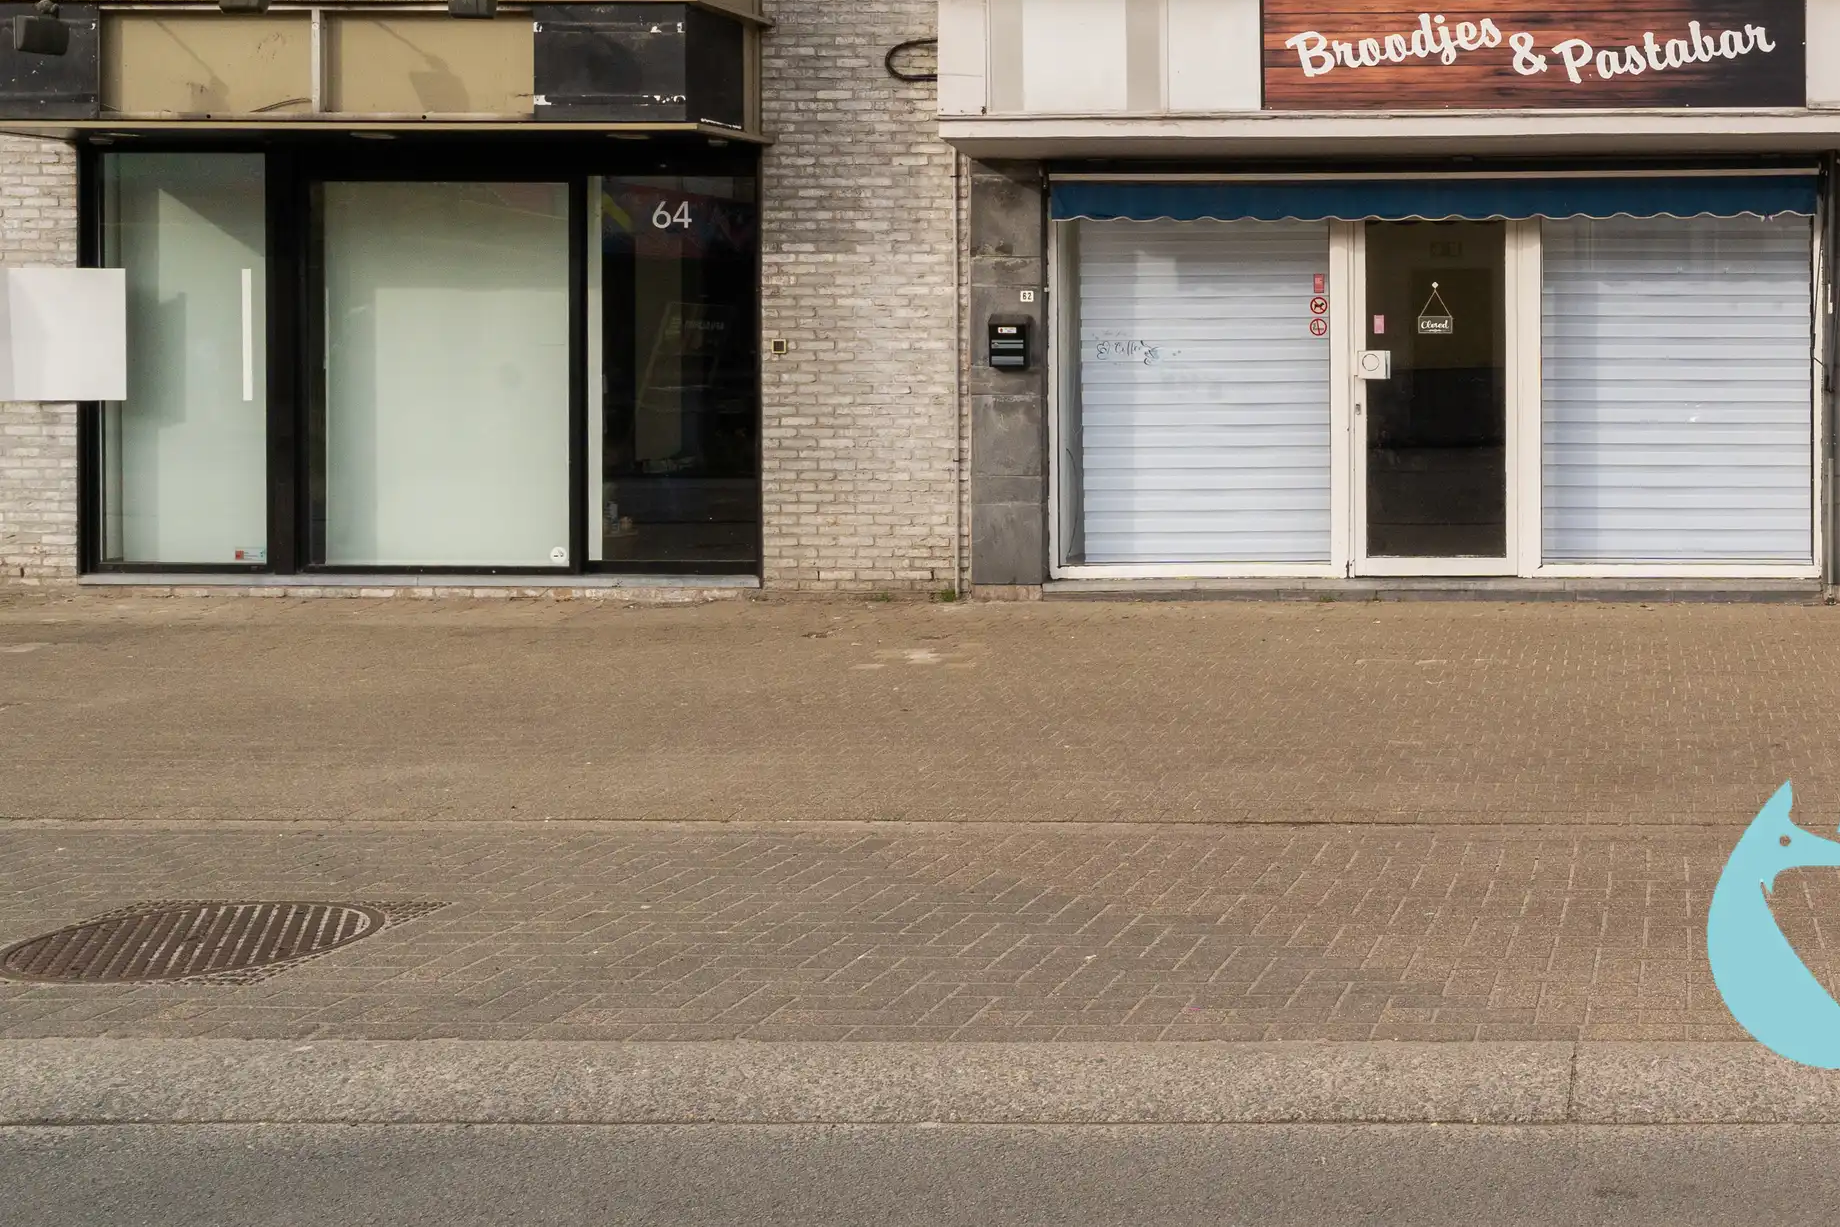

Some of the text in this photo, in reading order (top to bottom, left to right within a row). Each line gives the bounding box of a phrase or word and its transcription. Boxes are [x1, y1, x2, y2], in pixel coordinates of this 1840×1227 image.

[1285, 12, 1777, 85] Broodjes & Pastabar
[652, 200, 693, 229] 64
[1022, 292, 1032, 300] 62
[1420, 319, 1450, 330] Closed
